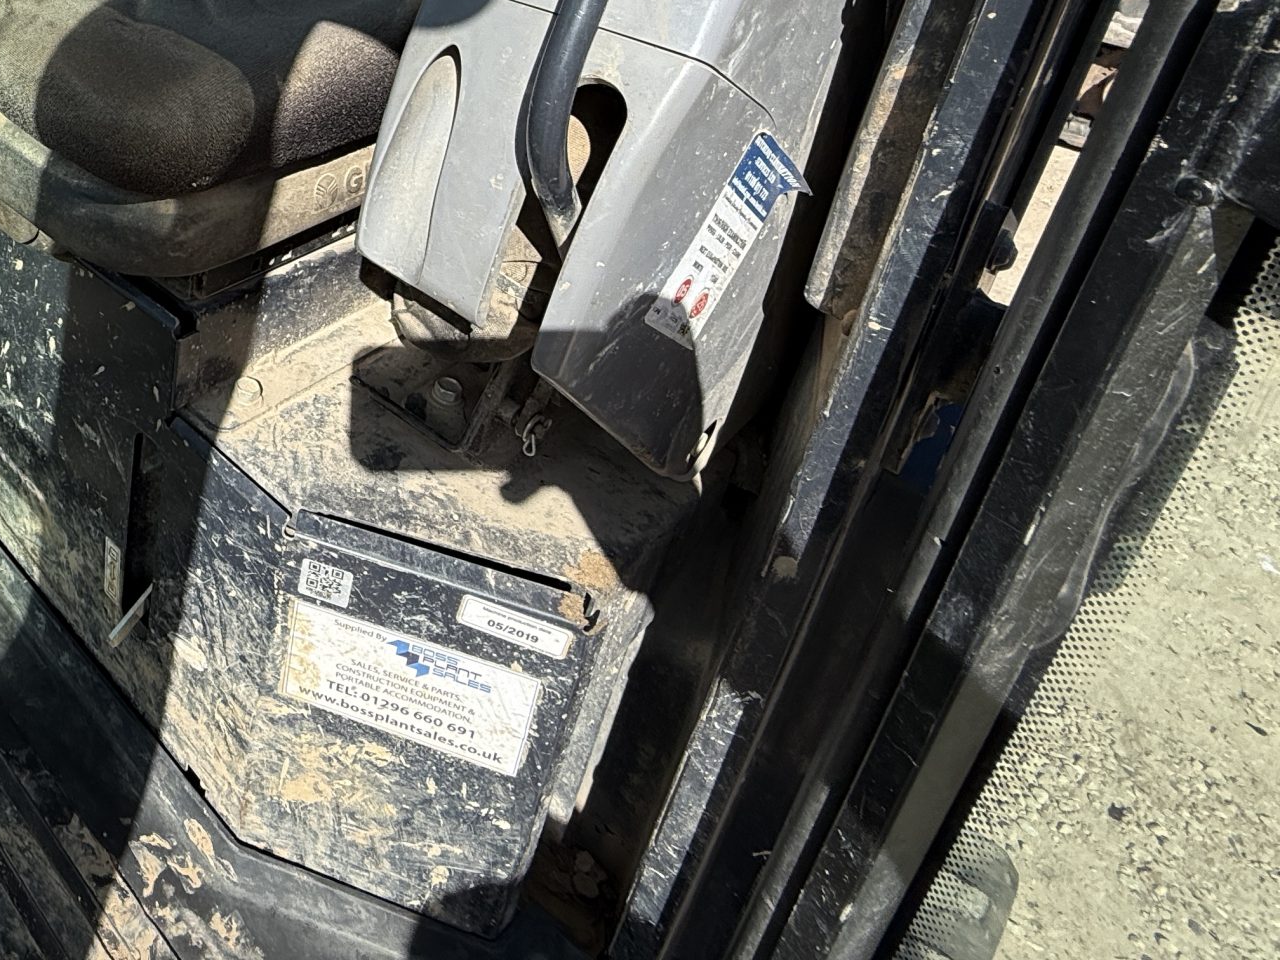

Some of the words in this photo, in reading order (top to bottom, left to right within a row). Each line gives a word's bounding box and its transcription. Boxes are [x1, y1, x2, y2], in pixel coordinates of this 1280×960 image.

[334, 619, 375, 639] Supplied
[375, 632, 387, 642] By
[487, 619, 539, 644] 05/2019
[411, 644, 459, 666] BOSS
[423, 655, 483, 679] PLANT
[335, 672, 381, 693] PORTABLE
[336, 663, 408, 694] CONSTRUCTION
[410, 689, 466, 713] EQUIPMENT
[382, 667, 421, 686] SERVICE
[432, 668, 492, 694] SALES
[326, 679, 358, 698] TEL:
[360, 689, 409, 715] 01296
[413, 708, 443, 728] 660
[446, 722, 475, 739] 691
[298, 685, 504, 765] www.bossplantsales.co.uk
